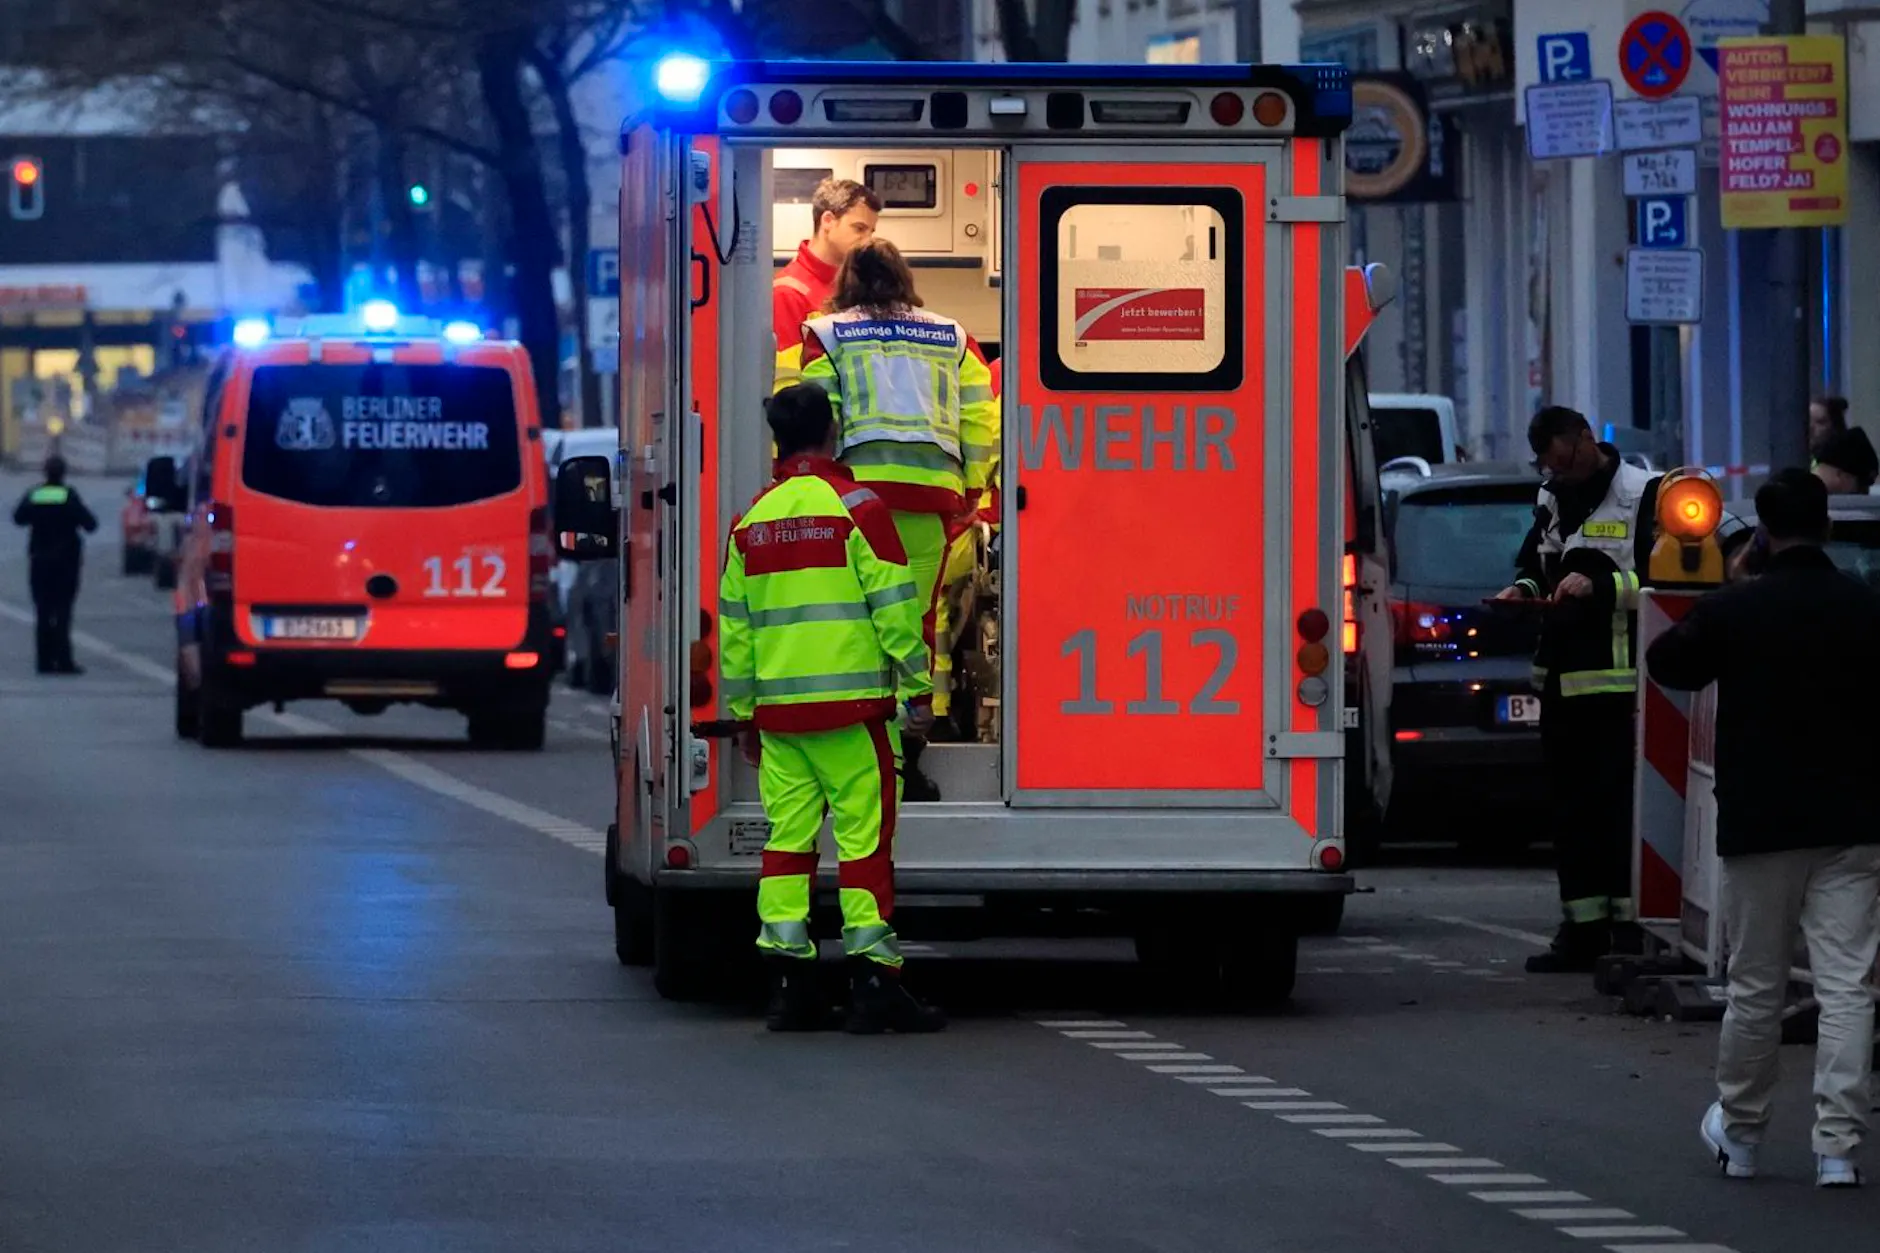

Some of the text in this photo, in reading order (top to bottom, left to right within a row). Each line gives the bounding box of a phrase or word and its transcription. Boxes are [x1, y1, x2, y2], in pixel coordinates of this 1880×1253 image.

[1546, 39, 1574, 81] P
[1726, 51, 1782, 65] AUTOS
[1726, 67, 1827, 82] VERBIETEN?
[1726, 85, 1771, 100] NEIN!
[1727, 102, 1832, 117] WOHNUNGS-
[1728, 120, 1793, 136] BAU AM
[1730, 138, 1802, 153] TEMPEL-
[1636, 154, 1680, 171] Mo-Fr
[1729, 156, 1786, 171] HOFER
[1729, 172, 1811, 189] FELD? JA!
[1647, 201, 1672, 243] P
[1120, 307, 1146, 318] Jetzt
[1147, 307, 1196, 317] bewerben
[836, 324, 956, 342] Leitende Notärztin
[342, 396, 443, 420] BERLINER
[343, 422, 489, 449] FEUERWEHR
[1019, 404, 1237, 471] WEHR
[775, 517, 815, 530] BERLER
[775, 527, 835, 544] FEUWEHR
[423, 555, 507, 597] 112
[1126, 594, 1241, 621] NOTRUF
[1060, 628, 1240, 715] 112
[1511, 698, 1524, 719] B
